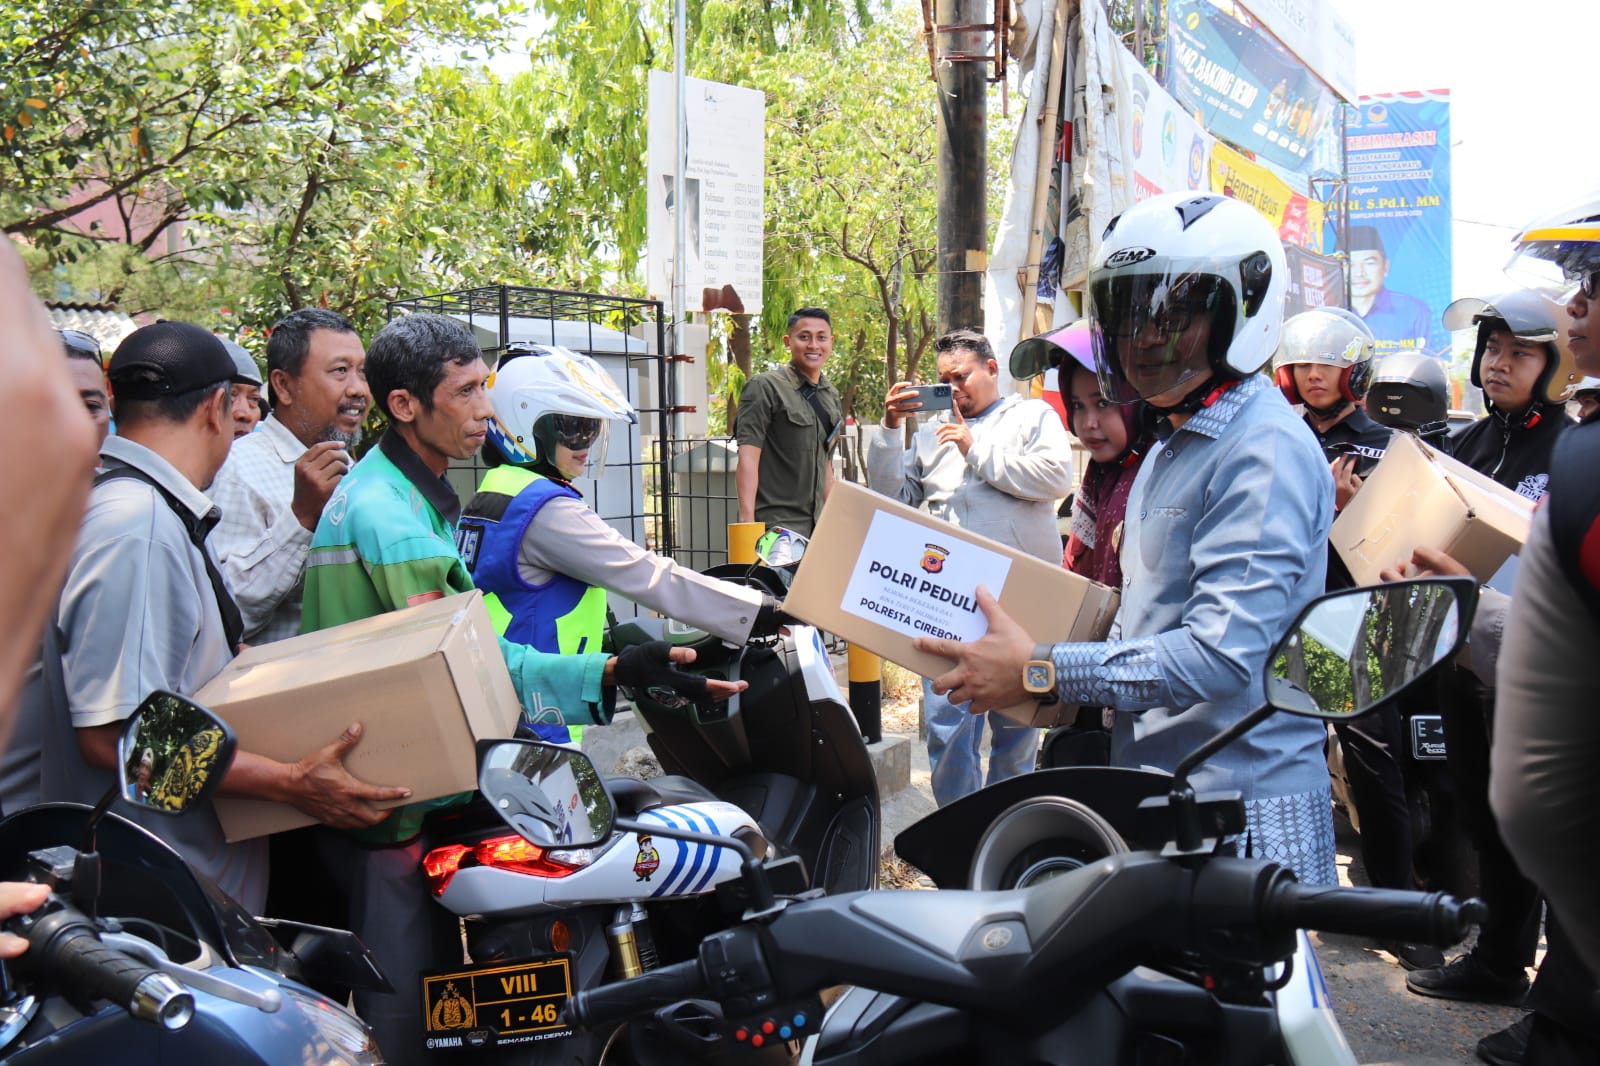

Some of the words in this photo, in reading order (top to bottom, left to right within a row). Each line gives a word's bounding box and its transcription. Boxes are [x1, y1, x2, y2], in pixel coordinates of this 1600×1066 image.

[1194, 56, 1235, 96] BAKING
[1224, 167, 1261, 205] Hemat
[1417, 195, 1440, 207] MM
[869, 561, 917, 589] POLRI
[919, 580, 978, 613] PEDULI
[860, 597, 911, 626] POLRESTA
[913, 620, 962, 642] CIREBON
[1417, 721, 1427, 737] E
[500, 973, 538, 995] VIII
[500, 1009, 511, 1027] 1
[530, 1004, 557, 1023] 46
[435, 1037, 463, 1048] YAMAHA
[497, 1036, 534, 1045] SEMAKIN
[543, 1030, 573, 1040] DEPAN
